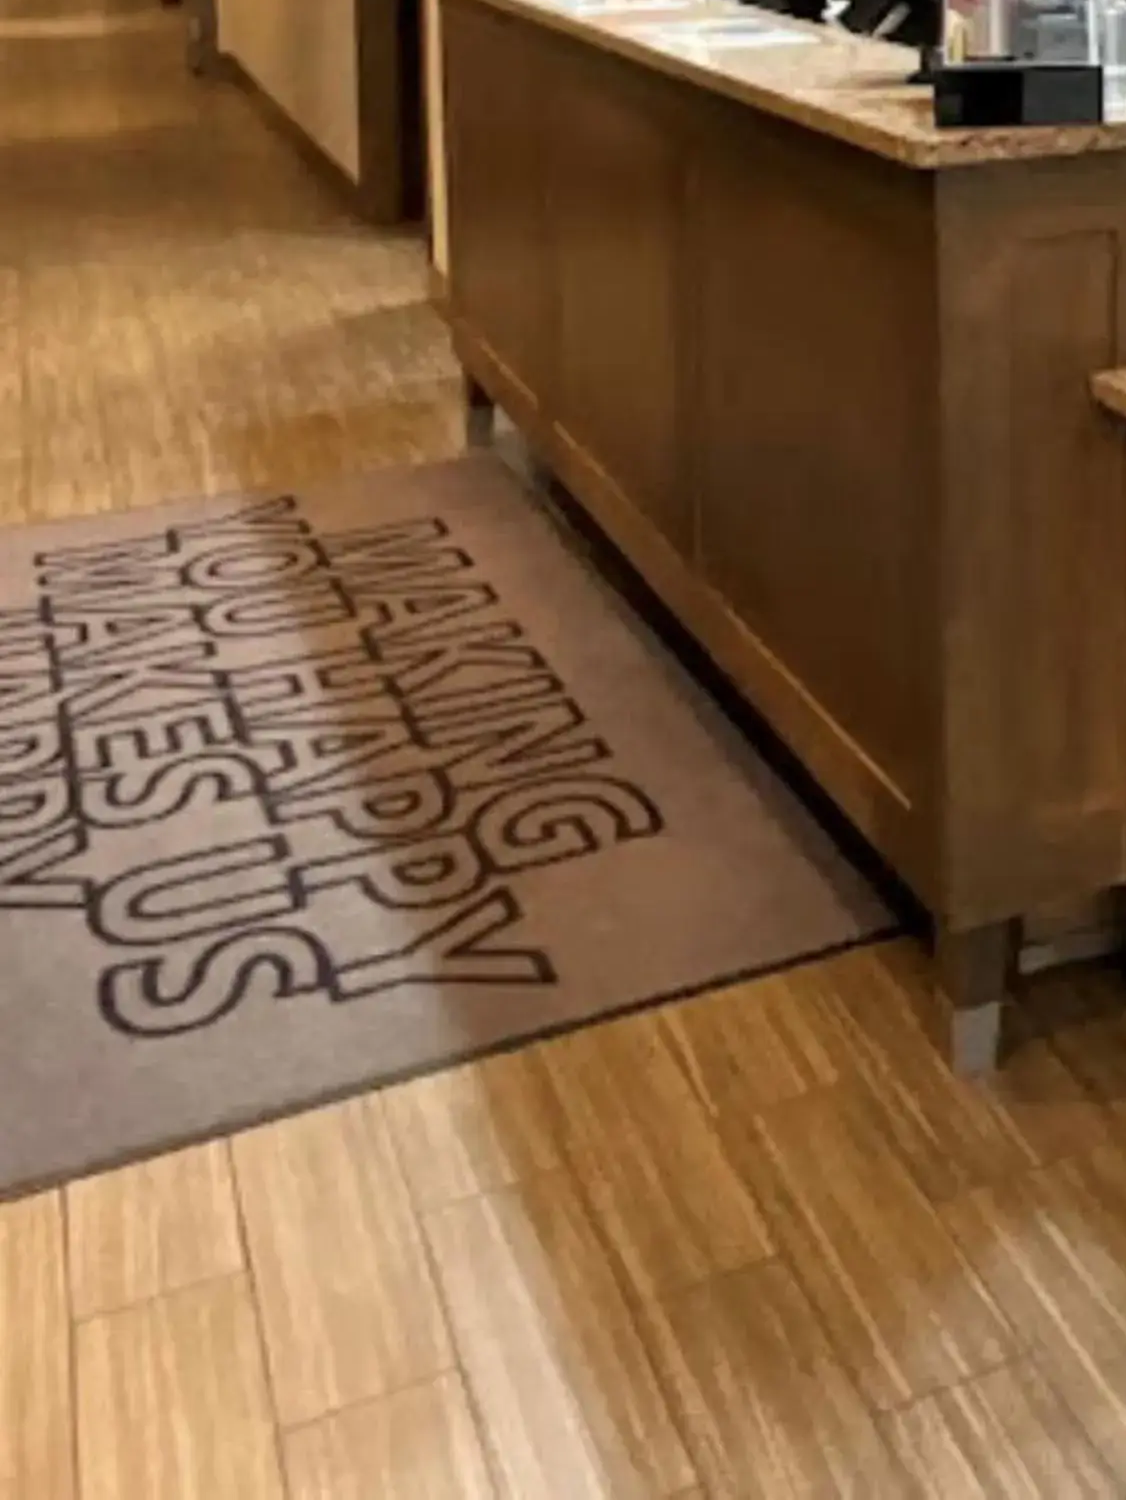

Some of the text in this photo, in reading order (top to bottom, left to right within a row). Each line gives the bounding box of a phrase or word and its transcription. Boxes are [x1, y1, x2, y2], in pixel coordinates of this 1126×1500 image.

[33, 532, 337, 1038] MAKES US
[166, 495, 557, 1004] YOU HAPPY
[306, 516, 664, 875] MAKING
